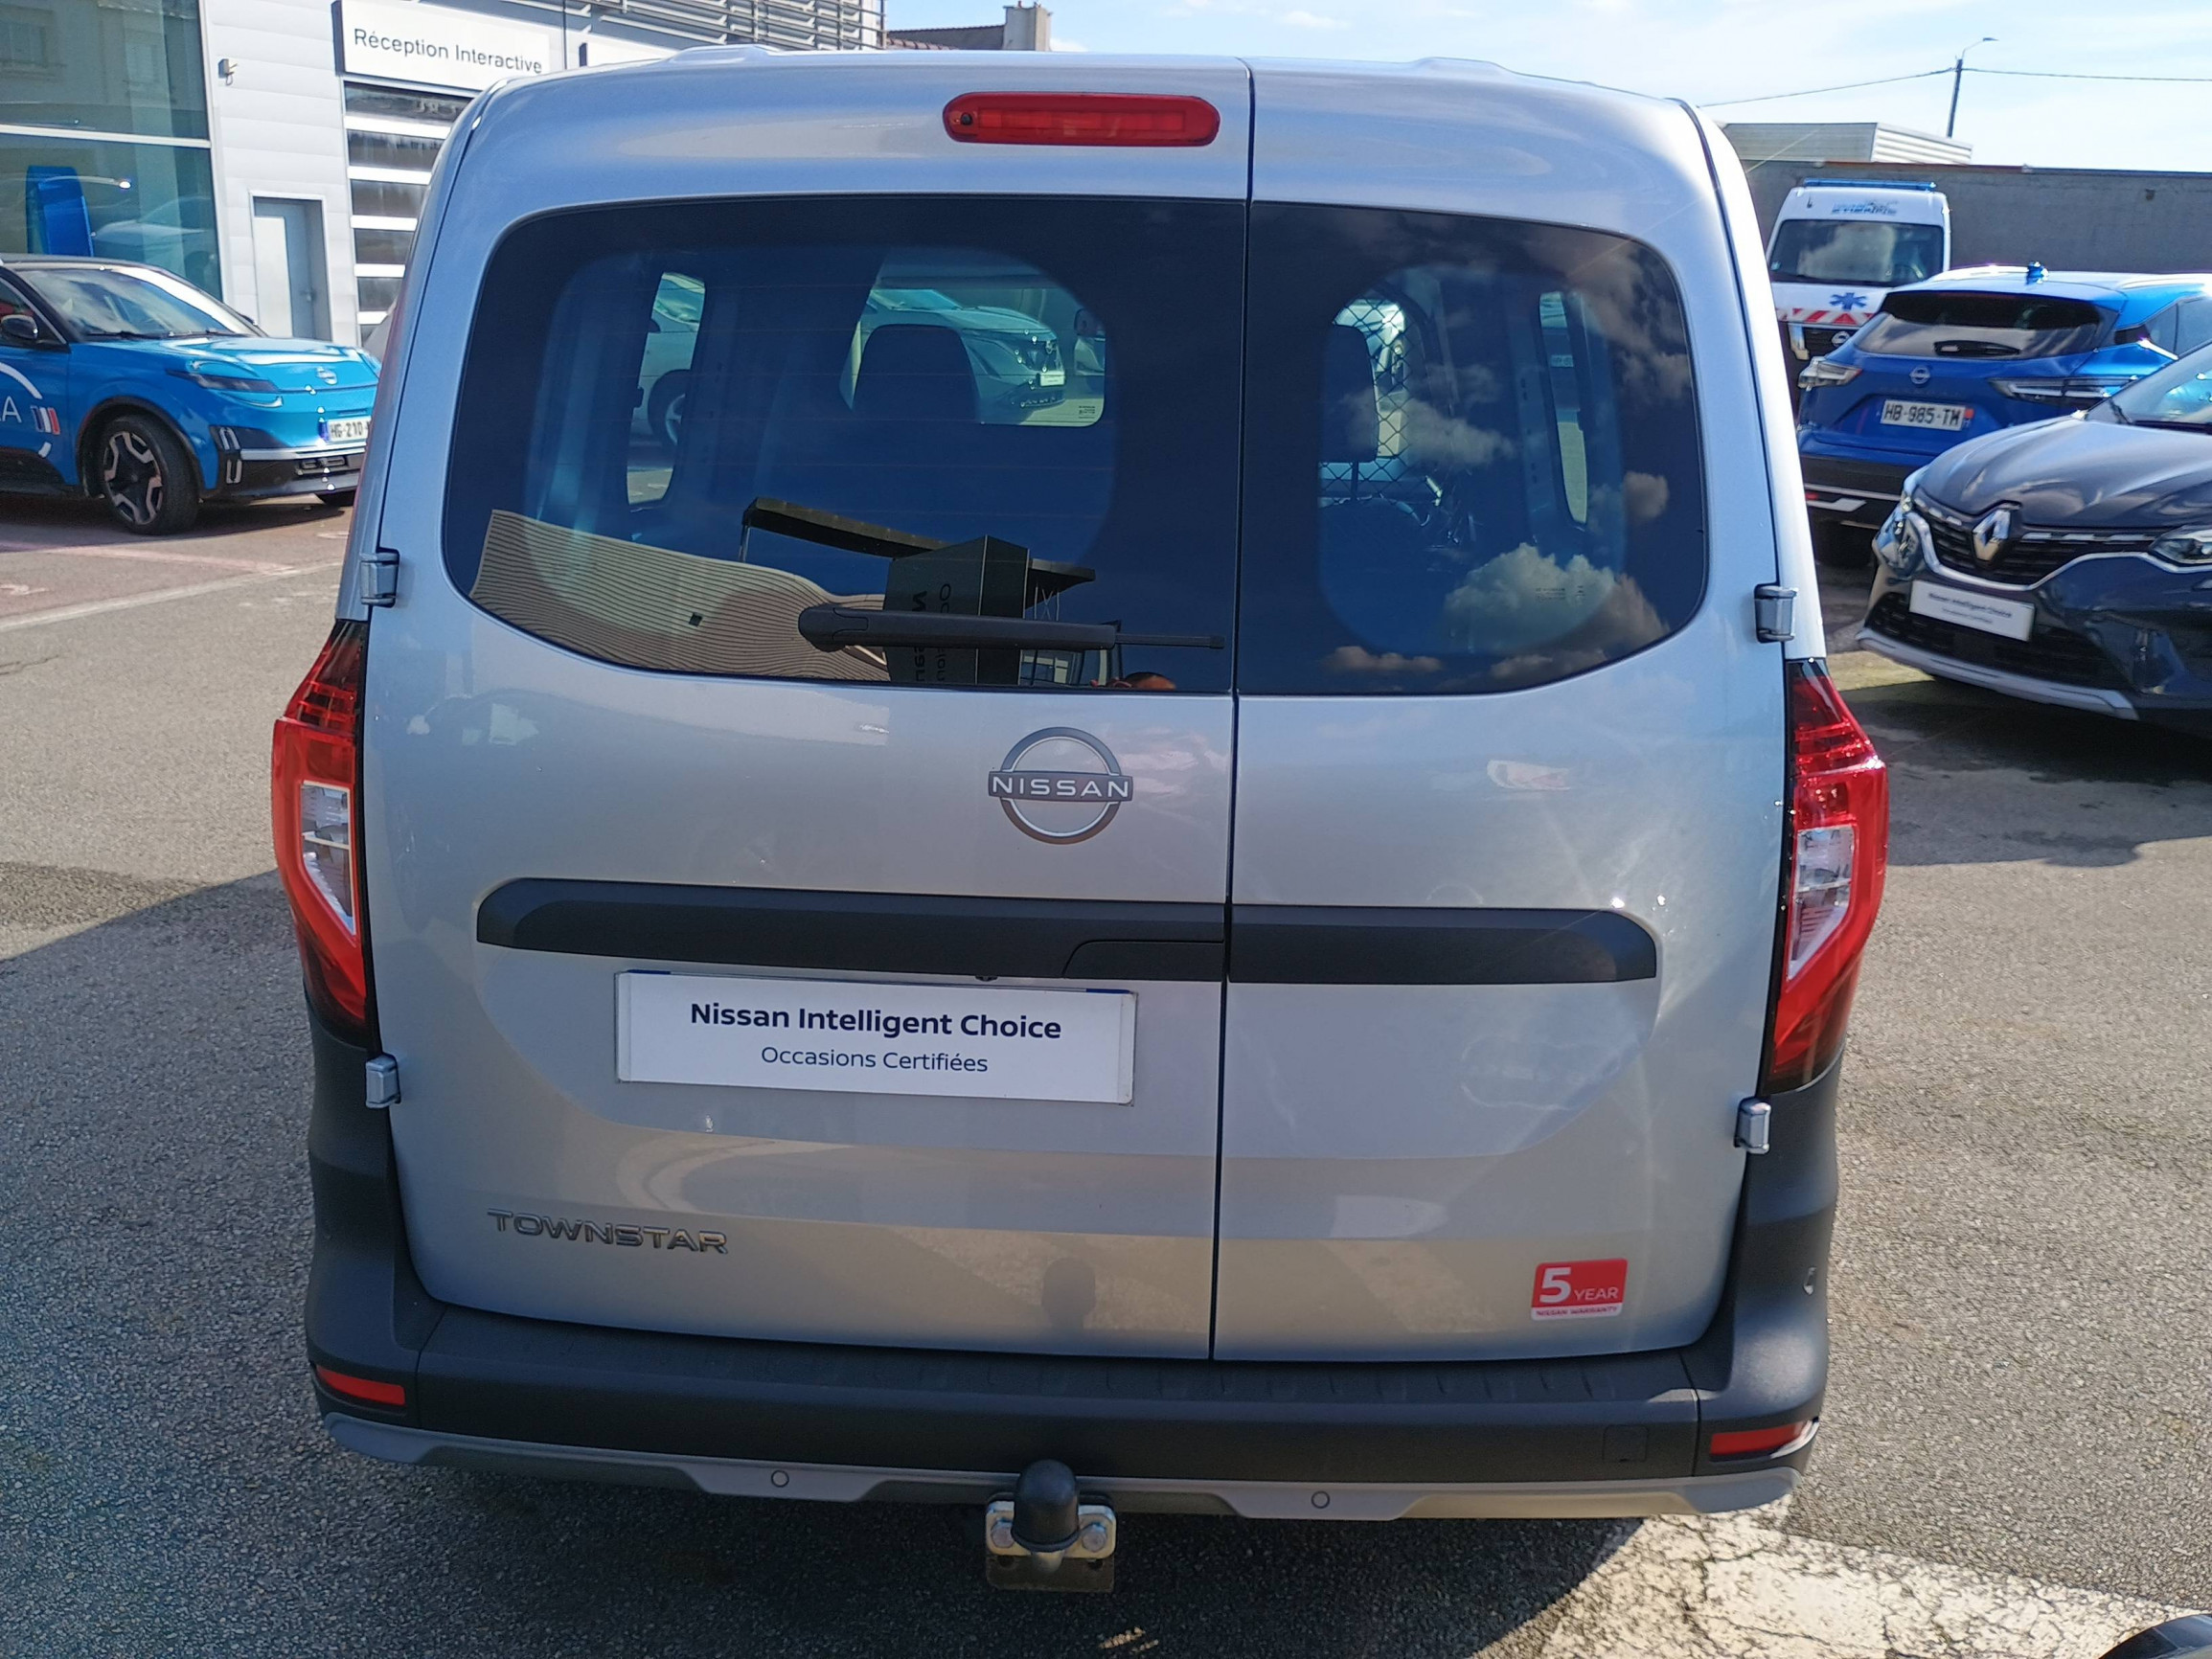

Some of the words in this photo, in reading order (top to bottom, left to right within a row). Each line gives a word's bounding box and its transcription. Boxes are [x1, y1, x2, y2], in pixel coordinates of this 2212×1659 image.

[354, 28, 449, 57] Réception
[455, 44, 542, 74] Interactive
[0, 396, 22, 422] A
[992, 776, 1129, 797] NISSAN
[691, 1003, 789, 1028] Nissan
[799, 1008, 952, 1038] Intelligent
[960, 1014, 1061, 1039] Choice
[761, 1047, 877, 1068] Occasions
[882, 1052, 989, 1072] Certifiées
[487, 1208, 728, 1254] TOWNSTAR
[1539, 1266, 1571, 1304] 5
[1574, 1286, 1619, 1302] YEAR
[1536, 1308, 1568, 1317] NISSAN
